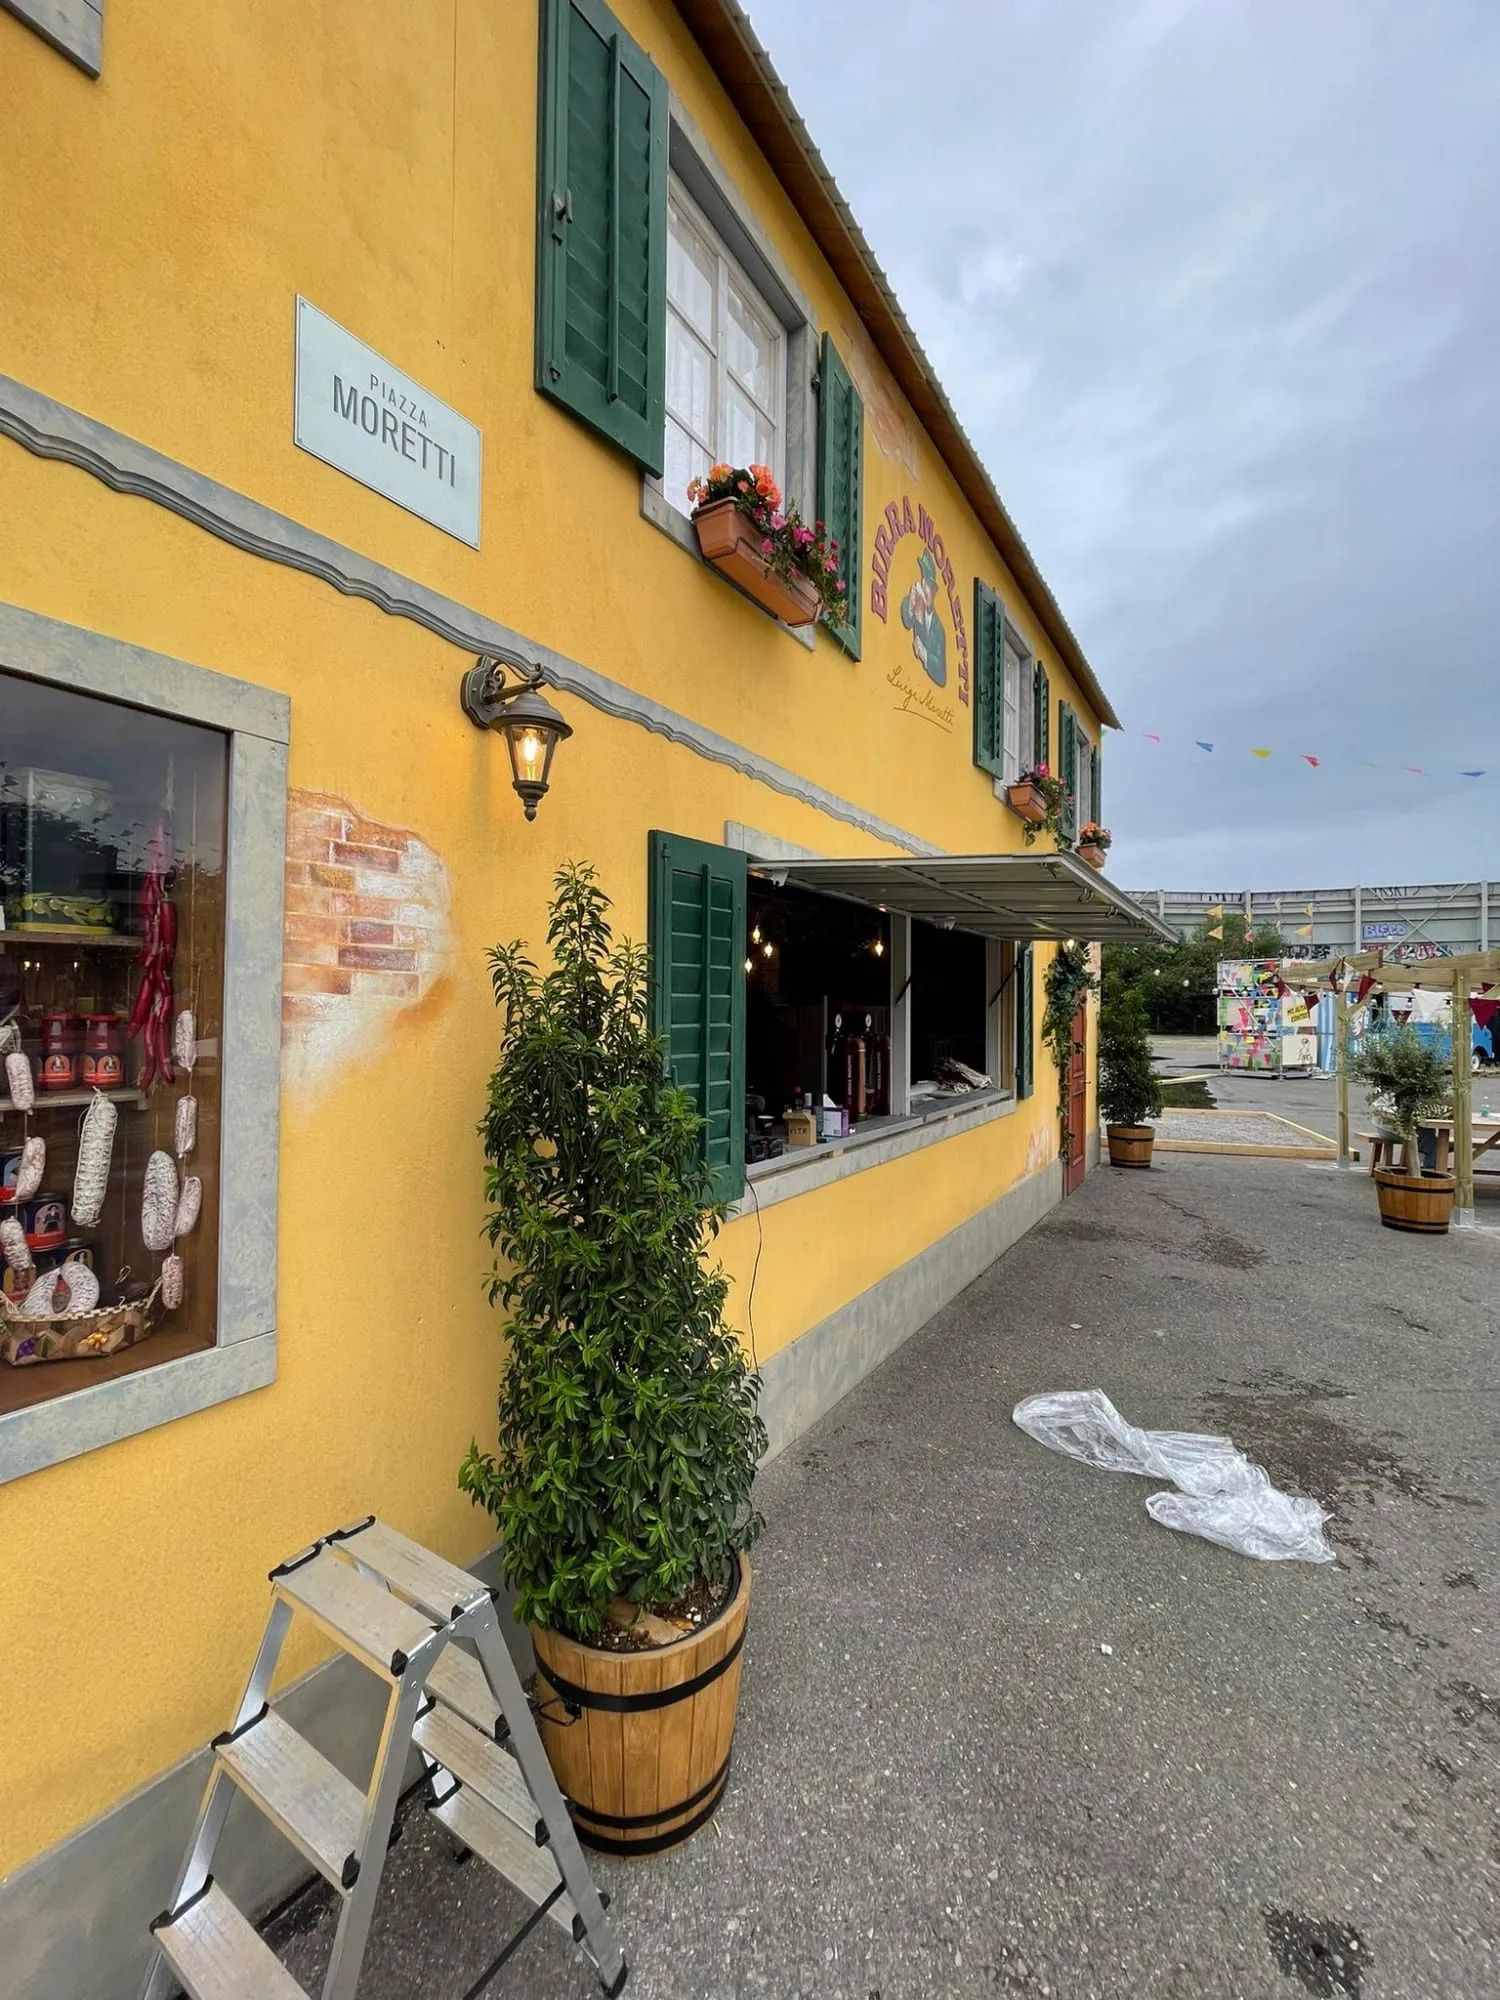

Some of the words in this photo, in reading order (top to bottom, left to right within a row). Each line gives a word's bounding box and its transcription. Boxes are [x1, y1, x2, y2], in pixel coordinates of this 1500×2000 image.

[333, 374, 456, 488] MORETTI
[370, 373, 428, 428] PIAZZA
[871, 495, 917, 625] BIRRA
[917, 503, 969, 708] MORETTI
